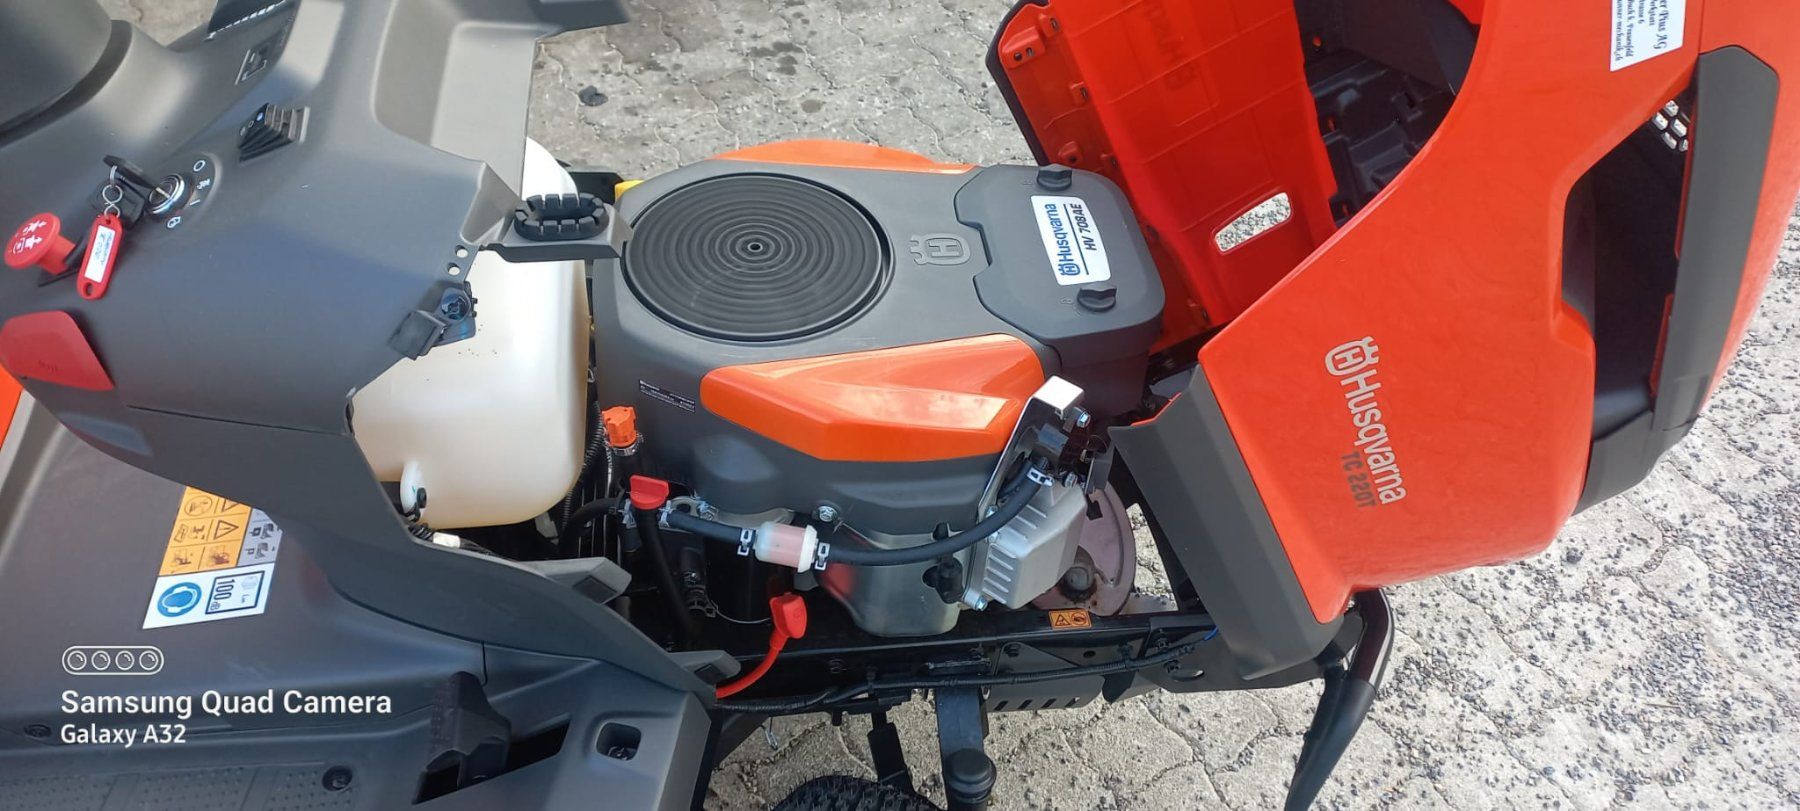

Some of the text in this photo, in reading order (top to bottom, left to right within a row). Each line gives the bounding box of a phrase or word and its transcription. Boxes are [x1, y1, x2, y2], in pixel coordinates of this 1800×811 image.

[1653, 33, 1668, 49] AG
[1044, 203, 1074, 262] Husqvarna
[1070, 203, 1097, 251] HV 708AE
[1340, 368, 1407, 505] Husqvarna
[1341, 451, 1377, 508] TC 220T
[214, 579, 235, 600] 100
